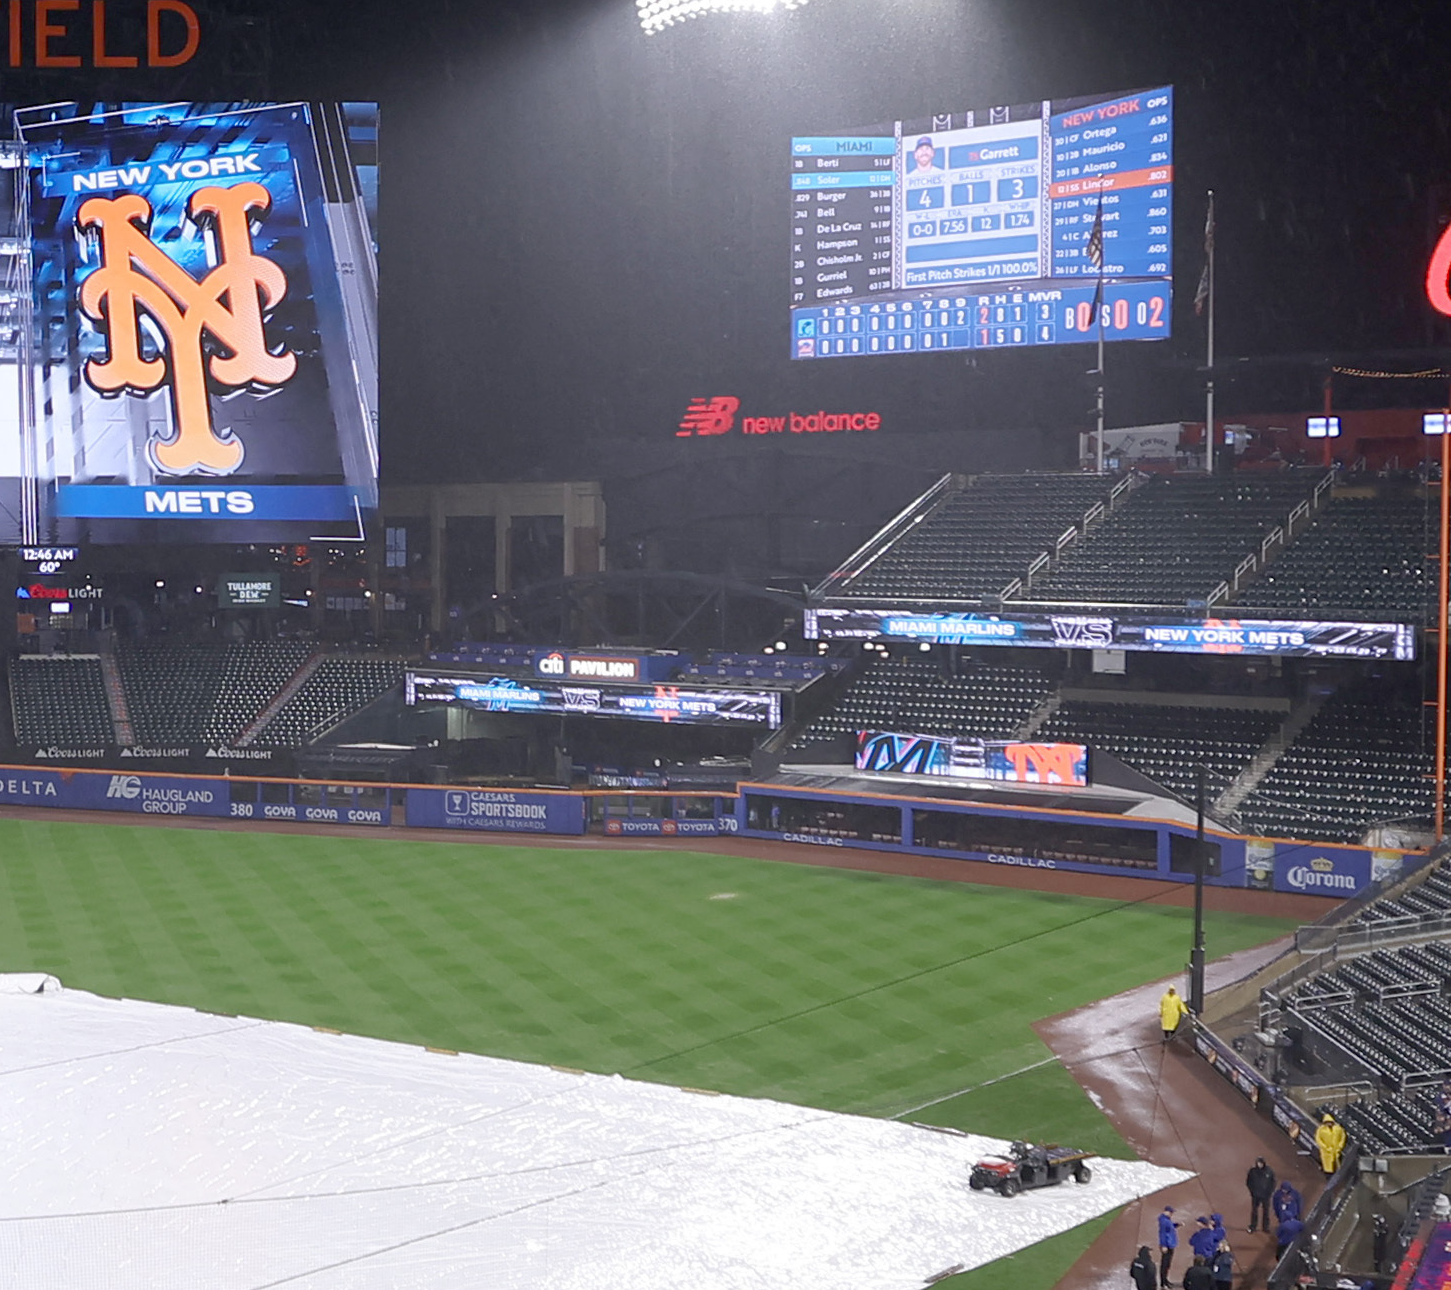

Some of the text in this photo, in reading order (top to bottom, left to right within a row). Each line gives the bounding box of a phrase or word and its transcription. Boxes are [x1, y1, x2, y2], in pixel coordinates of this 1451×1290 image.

[1062, 99, 1140, 128] NEW YORK
[1083, 126, 1117, 141] Ortega
[836, 141, 873, 152] MIAMI
[979, 146, 1020, 160] Garrett
[73, 152, 261, 192] NEW YORK
[1083, 161, 1117, 174] Alonso
[1012, 179, 1024, 198] 3
[919, 189, 932, 208] 4
[742, 415, 786, 434] new
[789, 411, 881, 433] balance
[144, 490, 254, 514] METS
[23, 549, 74, 561] 12:46 AM
[68, 588, 103, 599] LIGHT
[226, 582, 272, 591] TULLAMORE
[888, 620, 939, 634] MIAMI
[941, 622, 1015, 636] MARLINS
[1144, 627, 1189, 642] NEW
[1192, 628, 1245, 644] YORK
[1249, 630, 1304, 646] METS
[539, 654, 635, 677] citi PAVILION
[77, 749, 105, 758] LIGHT
[163, 748, 190, 758] LIGHT
[246, 750, 272, 760] LIGHT
[143, 788, 213, 803] HAUGLAND
[471, 792, 516, 803] CAESARS
[142, 801, 188, 815] GROUP
[230, 803, 253, 817] 380
[264, 806, 297, 818] GOYA
[305, 807, 338, 820] GOYA
[470, 802, 547, 820] SPORTSBOOK
[348, 809, 382, 823] GOYA
[622, 822, 660, 832] TOYOTA
[677, 822, 715, 832] TOYOTA
[718, 817, 739, 832] 370
[783, 832, 844, 847] CADILLAC
[1286, 865, 1357, 890] Corona
